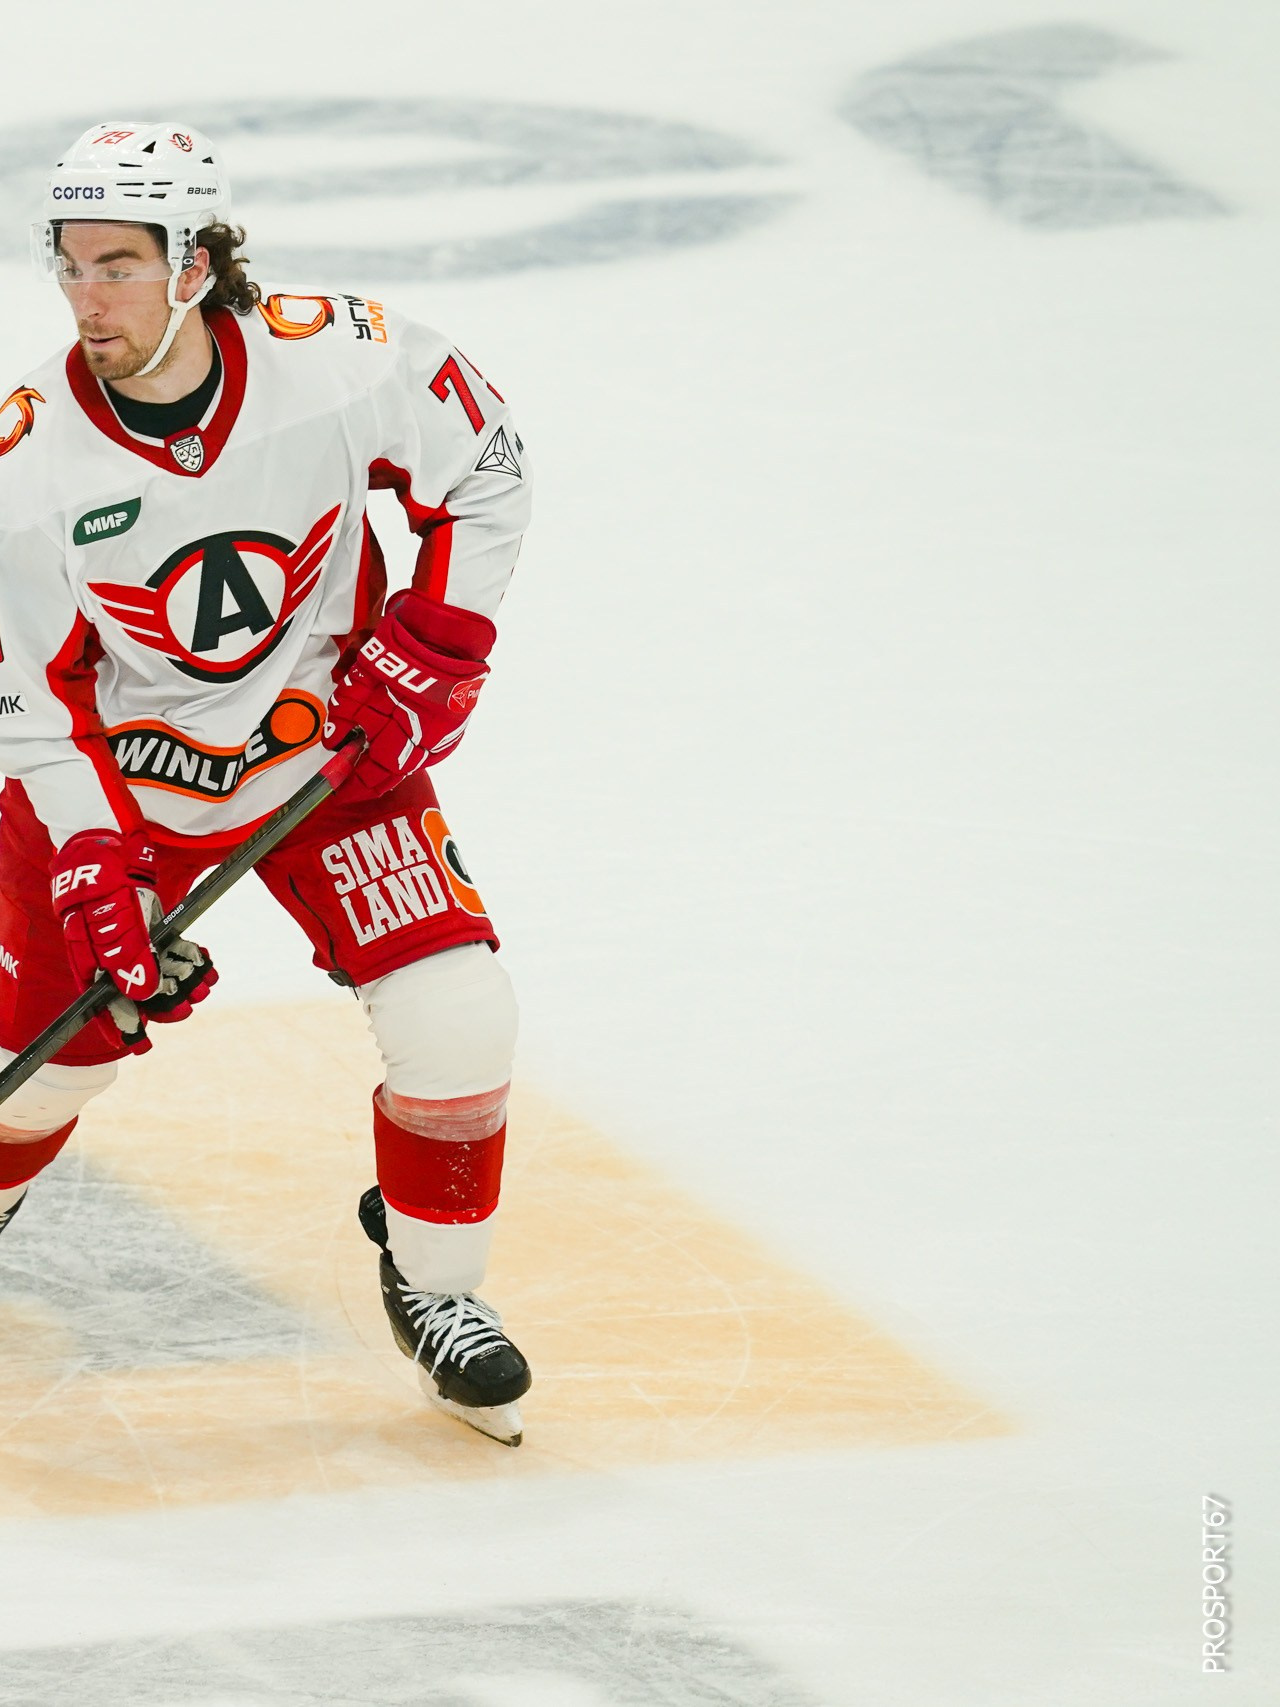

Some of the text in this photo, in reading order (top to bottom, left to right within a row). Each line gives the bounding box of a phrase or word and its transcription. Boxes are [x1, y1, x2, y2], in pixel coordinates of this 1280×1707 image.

[92, 131, 135, 145] 79
[428, 345, 505, 436] 7
[83, 511, 128, 536] МИР
[321, 816, 429, 895] SIMA
[51, 864, 102, 903] ER
[163, 903, 185, 925] GROSS
[340, 862, 449, 947] LAND
